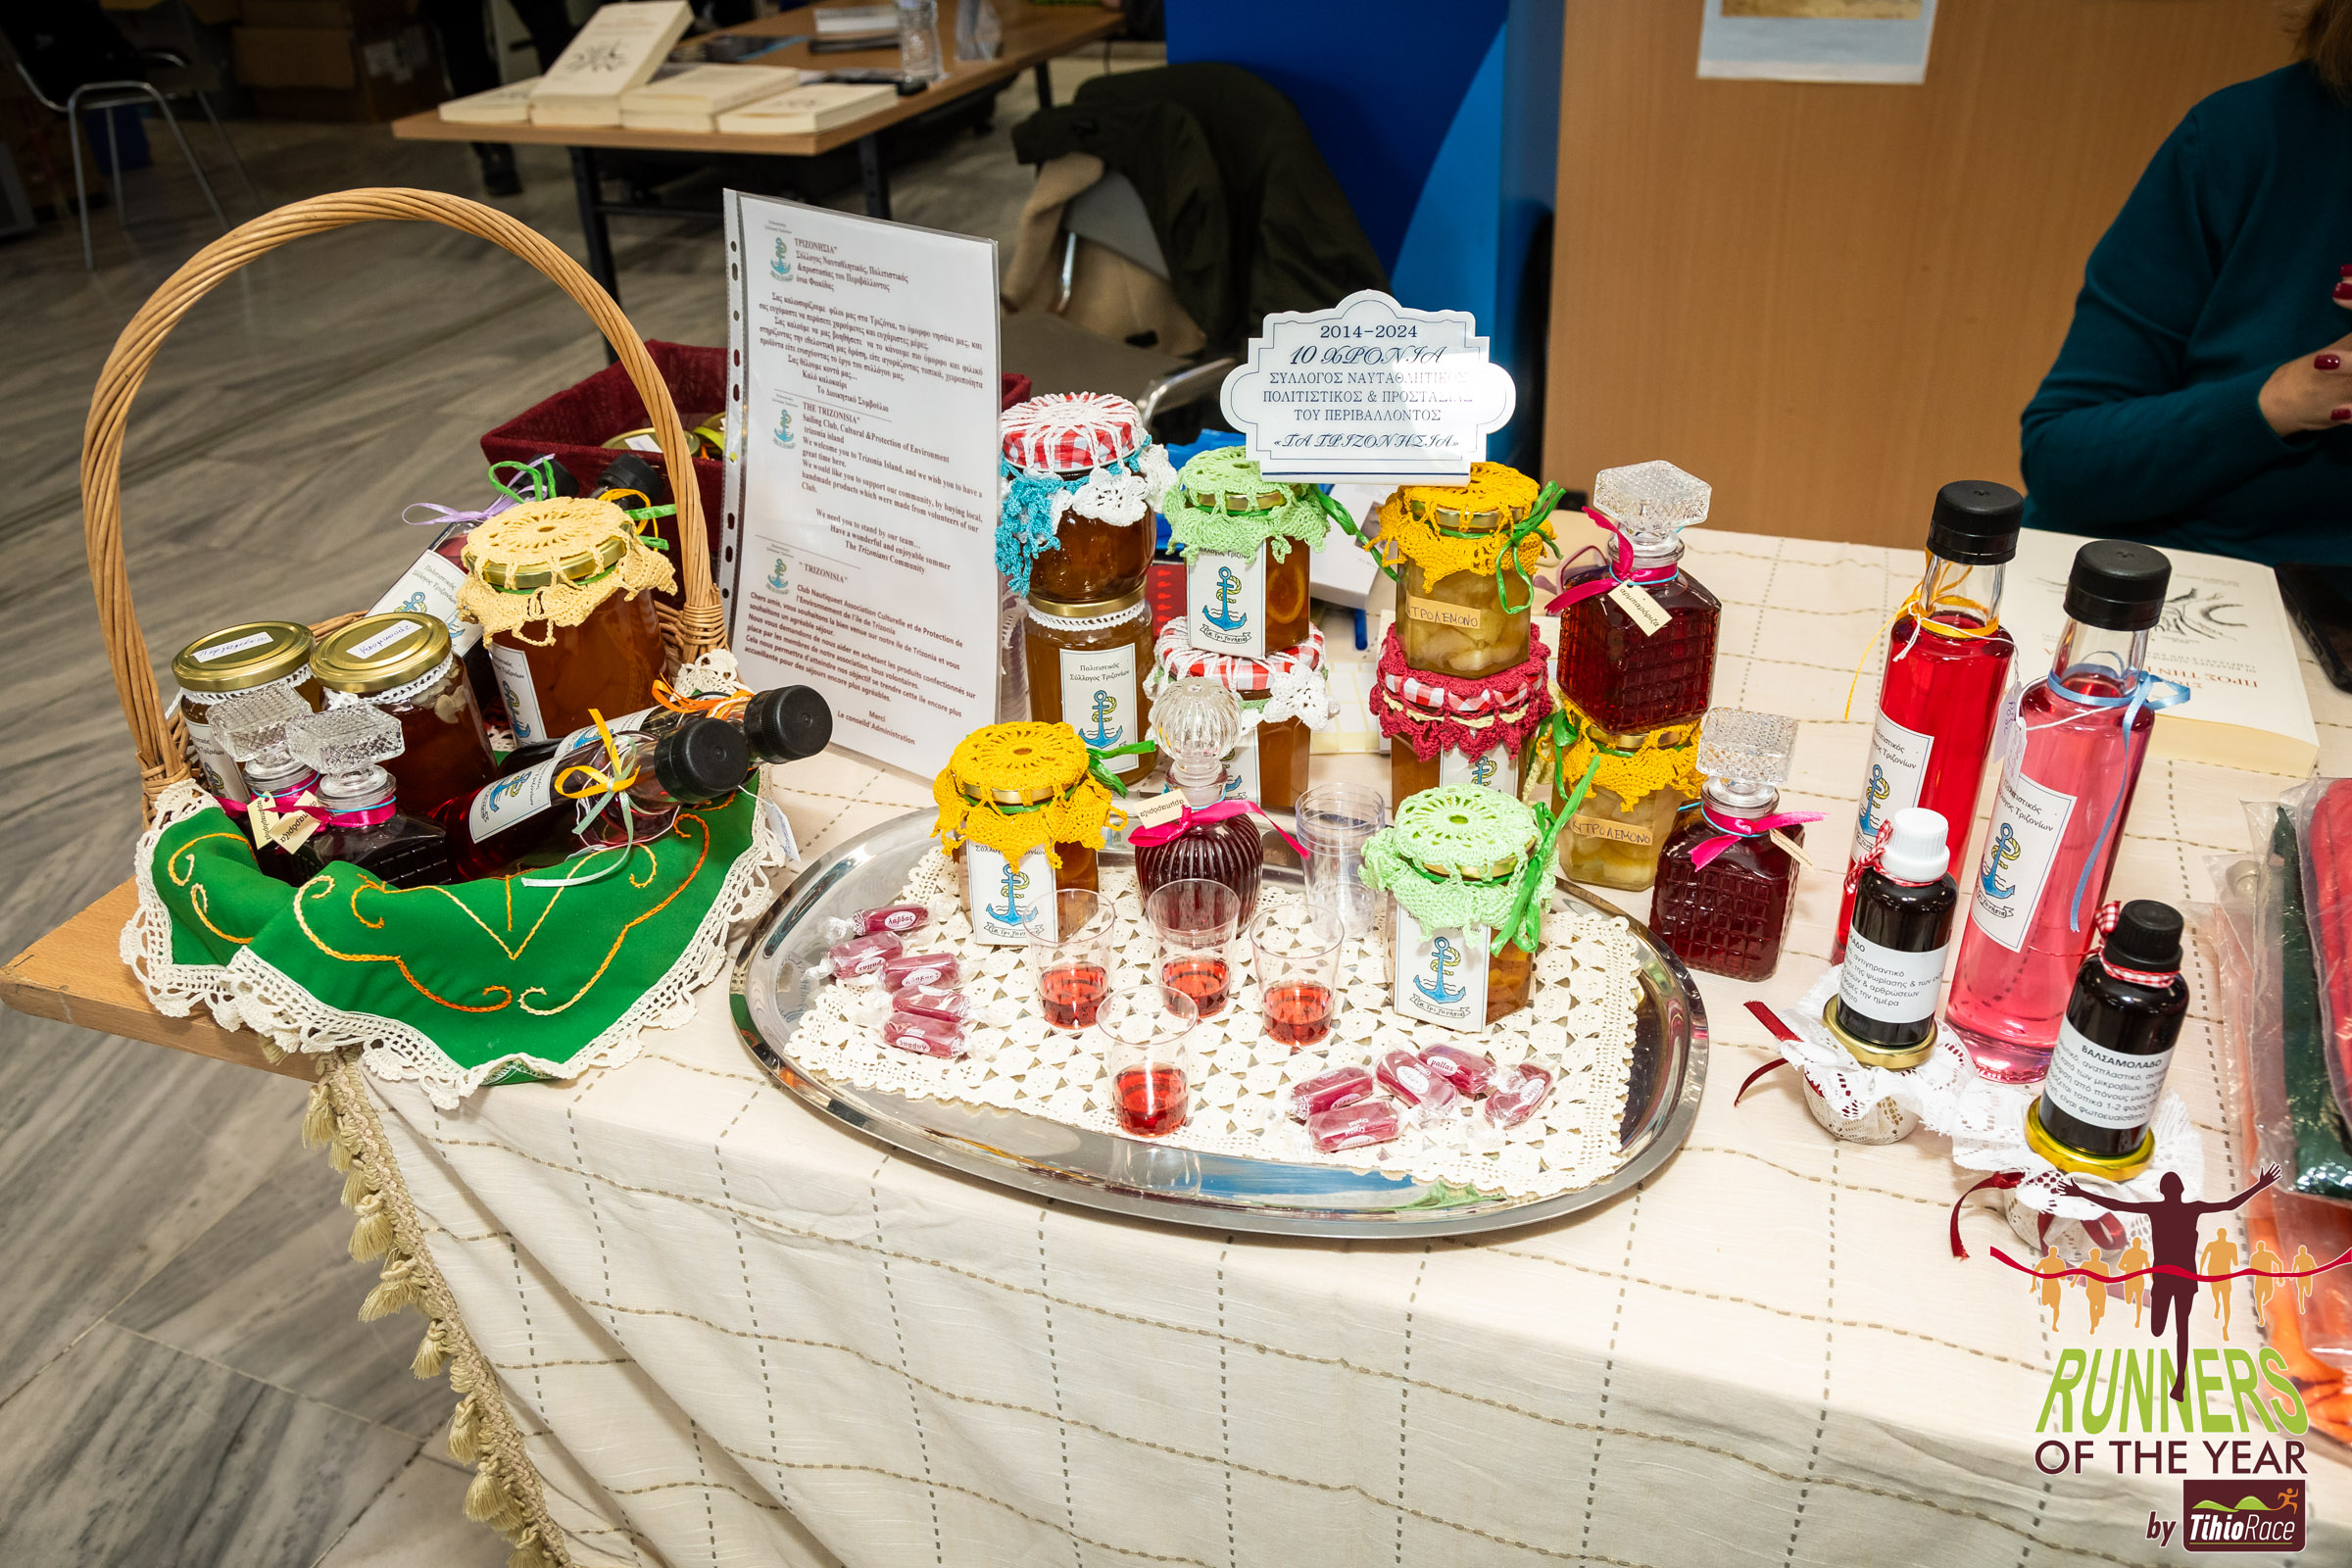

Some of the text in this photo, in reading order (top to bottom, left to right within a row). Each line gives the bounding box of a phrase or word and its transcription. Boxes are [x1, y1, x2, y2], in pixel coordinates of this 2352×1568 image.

[1320, 324, 1417, 339] 2014-2024
[1290, 346, 1317, 365] 10
[1269, 372, 1343, 384] ΣΥΛΛΟΓΟΣ
[1262, 390, 1362, 403] ΠΟΛΙΤΙΣΤΙΚΟΣ
[1367, 391, 1377, 402] &
[803, 401, 859, 423] THE TRIZONISIA"
[1294, 409, 1442, 421] ΤΟΥ ΠΕΡΙΒΑΛΛΟΝΤΟΣ
[802, 413, 949, 462] Sailing Club, Cultural &Protection of Environment
[804, 425, 844, 443] trizonia island
[802, 449, 846, 467] great time here.
[802, 435, 811, 446] We
[812, 441, 837, 453] welcome
[838, 448, 849, 457] you
[858, 452, 882, 466] Trizonia
[883, 460, 904, 473] Island,
[917, 471, 926, 480] we
[927, 474, 941, 484] wish
[942, 479, 954, 488] you
[955, 482, 961, 491] to
[962, 484, 977, 496] have
[801, 481, 816, 492] Club.
[802, 458, 811, 468] We
[812, 464, 830, 473] would
[831, 466, 842, 477] like
[843, 472, 854, 481] you
[862, 478, 885, 490] support
[898, 490, 933, 507] community,
[935, 499, 943, 511] by
[944, 502, 964, 517] buying
[965, 510, 982, 522] local,
[802, 470, 831, 485] handmade
[832, 481, 858, 493] products
[858, 488, 876, 500] which
[878, 495, 892, 505] were
[893, 500, 909, 510] made
[910, 504, 926, 515] from
[927, 511, 958, 525] volunteers
[815, 508, 825, 517] We
[826, 514, 840, 522] need
[841, 517, 853, 526] you
[860, 524, 877, 534] stand
[878, 527, 886, 539] by
[887, 532, 898, 541] our
[899, 536, 920, 549] team...
[830, 523, 845, 535] Have
[852, 532, 881, 547] wonderful
[882, 543, 894, 552] and
[895, 547, 924, 562] enjoyable
[925, 557, 951, 569] summer
[845, 539, 924, 574] The Trizonians Community
[804, 563, 847, 582] TRIZONISIA"
[1619, 588, 1660, 627] αρμπαρόριζα
[1080, 662, 1119, 671] Πολιτιστικός
[1102, 669, 1130, 681] Τριζονίων
[1882, 748, 1917, 769] Τριζονίων
[2015, 808, 2054, 832] Τριζονίων
[1853, 955, 1904, 977] αντιγηραντικό
[1870, 984, 1920, 998] αρθρώσεων
[1873, 996, 1899, 1006] ημέρα
[1431, 1058, 1454, 1072] pallas
[2082, 1045, 2162, 1069] ΒΑΛΣΑΜΟΛΑΔΟ
[2074, 1078, 2091, 1092] από
[2094, 1089, 2130, 1102] πόνους
[2074, 1091, 2103, 1107] τοπικά
